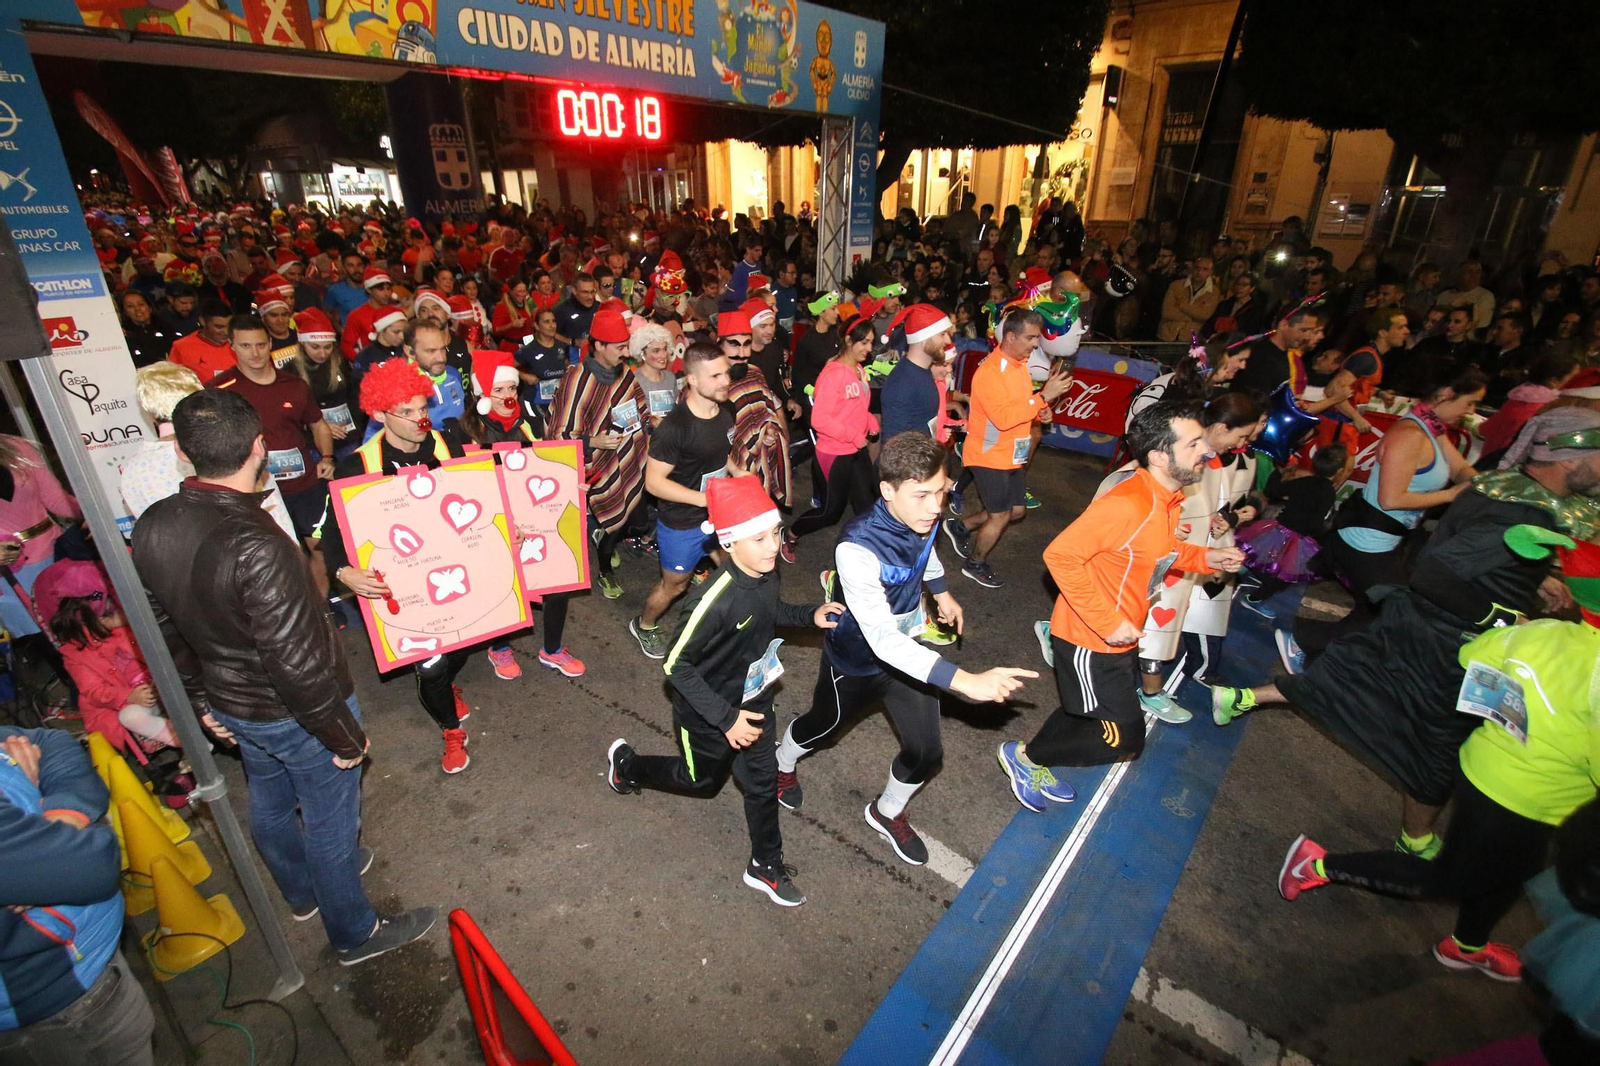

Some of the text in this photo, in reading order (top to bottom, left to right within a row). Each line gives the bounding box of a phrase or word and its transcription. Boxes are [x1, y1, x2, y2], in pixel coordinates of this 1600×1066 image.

[457, 7, 697, 78] CIUDAD DE ALMERÍA
[841, 72, 875, 90] ALMERÍA
[11, 228, 57, 240] GRUPO
[54, 240, 81, 252] CAR
[81, 383, 128, 415] Paquita
[275, 456, 302, 468] 1358
